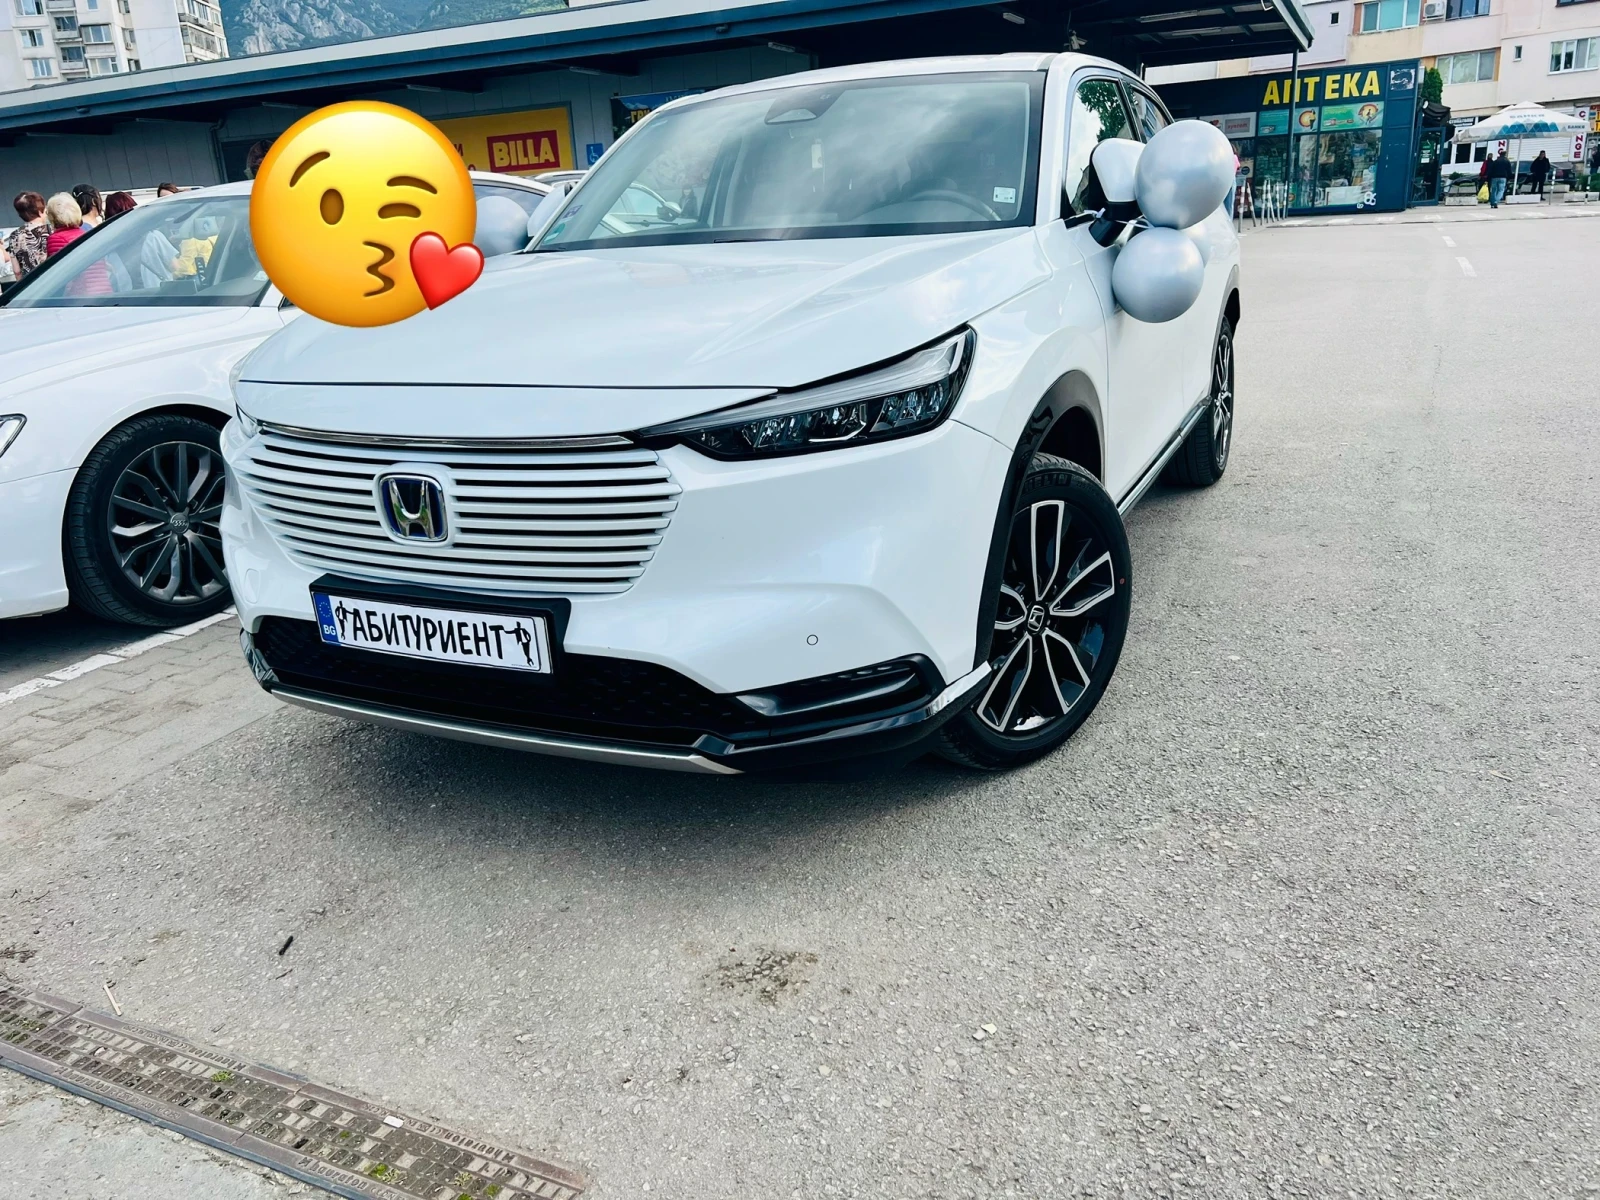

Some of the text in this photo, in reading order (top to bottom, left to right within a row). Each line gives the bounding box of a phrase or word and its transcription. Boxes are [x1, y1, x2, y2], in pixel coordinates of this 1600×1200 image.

[1262, 70, 1380, 106] АПТЕКА
[492, 137, 555, 168] BILLA
[323, 624, 337, 637] BG
[351, 607, 505, 660] АБИТУРИЕНТ
